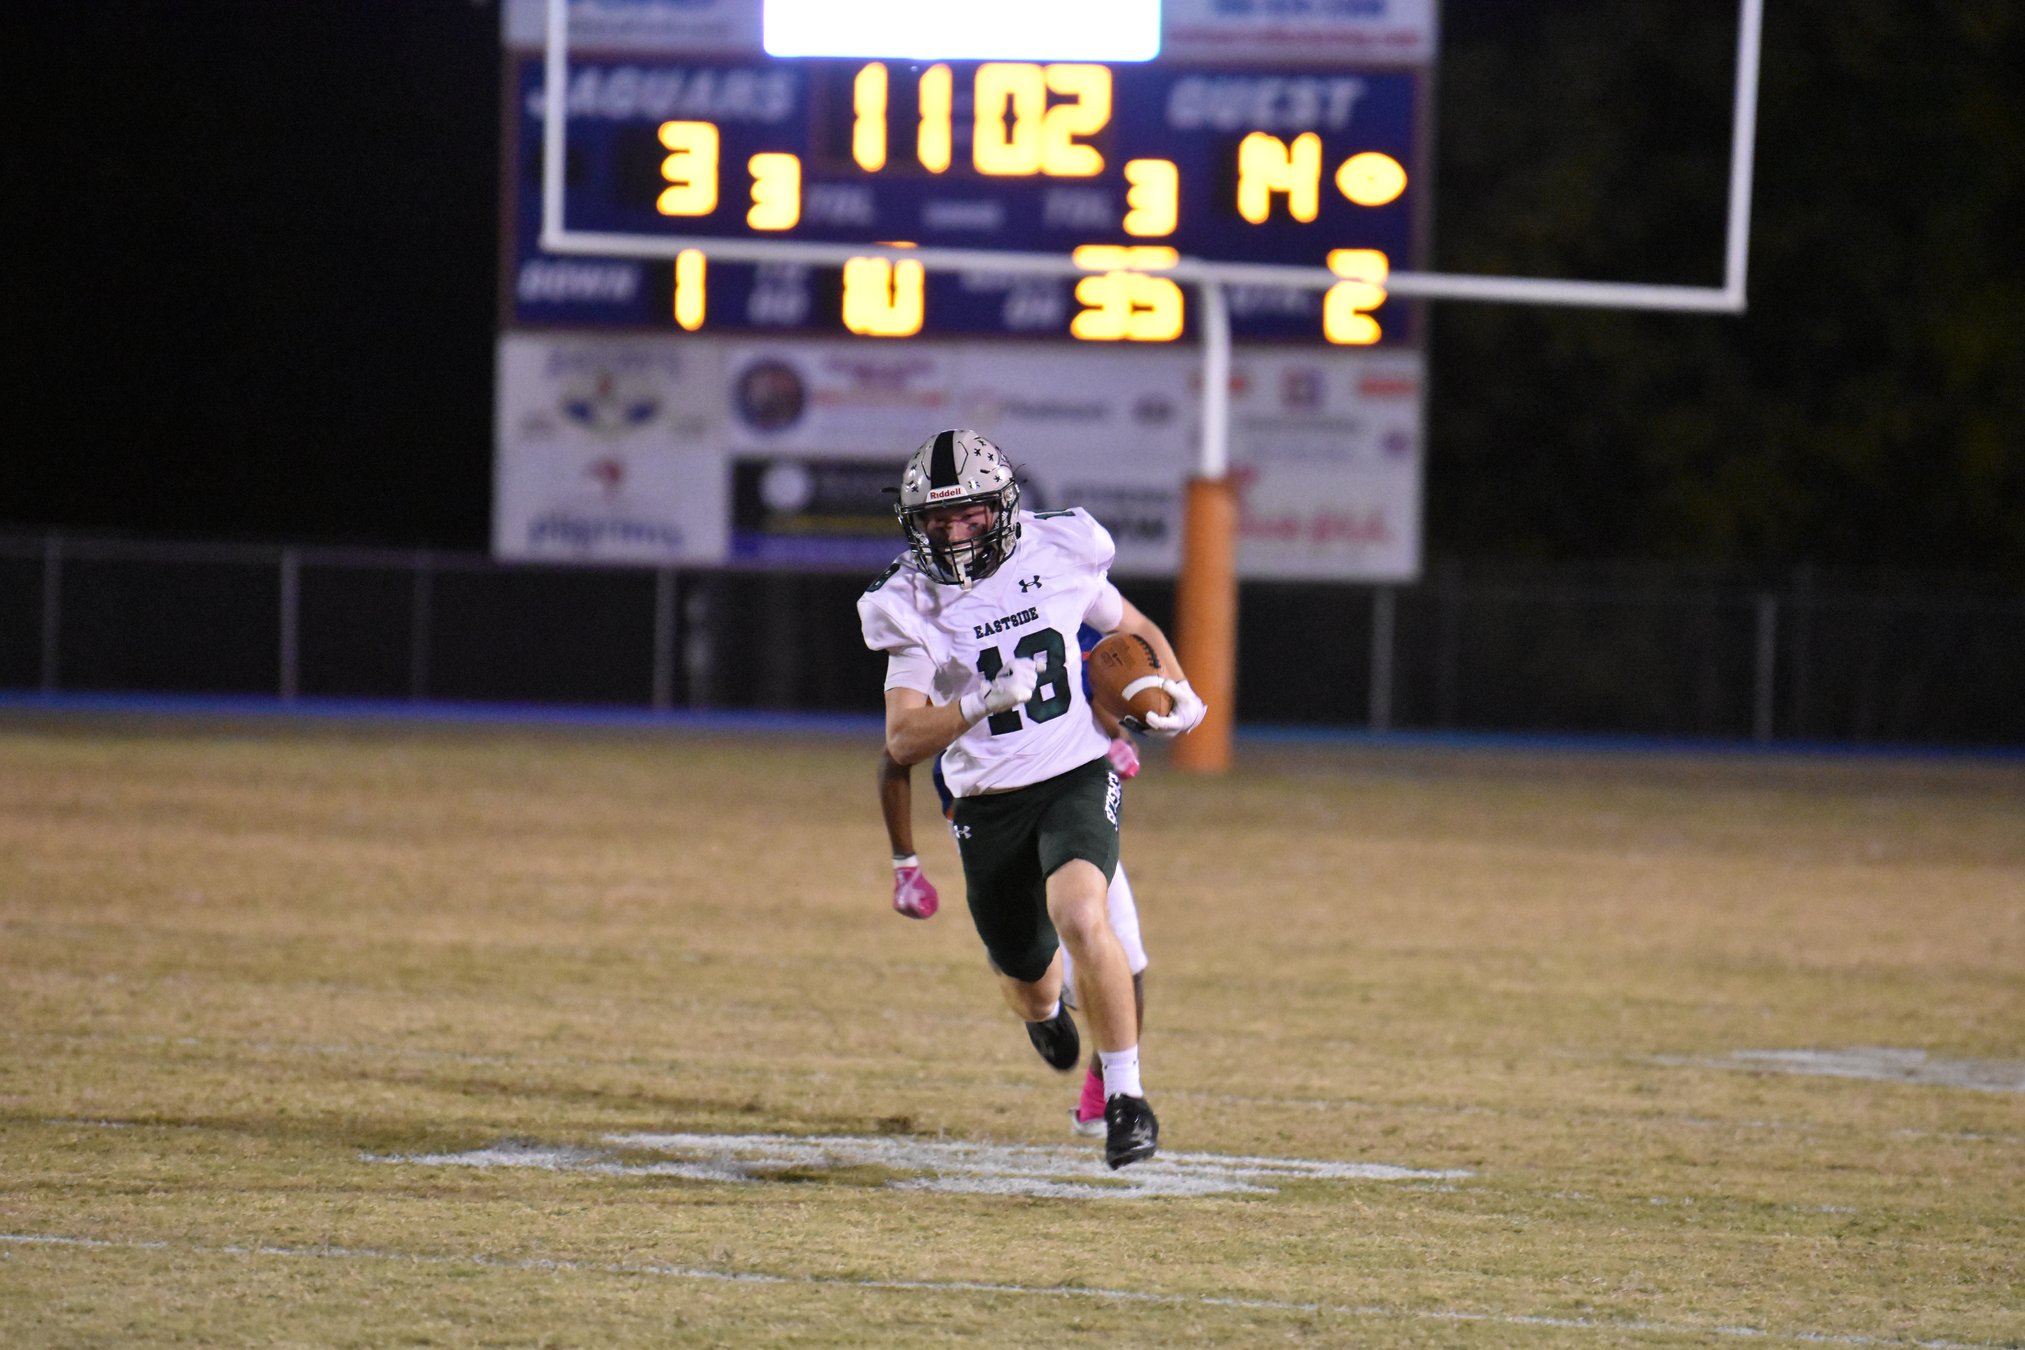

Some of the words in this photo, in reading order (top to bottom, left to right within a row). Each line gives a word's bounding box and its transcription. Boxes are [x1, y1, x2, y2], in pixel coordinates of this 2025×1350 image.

[657, 121, 719, 216] 3
[747, 153, 801, 230] 3
[1123, 159, 1179, 237] 3
[675, 248, 706, 331] 1
[930, 487, 961, 499] Riddell
[973, 606, 1039, 640] EASTSIDE
